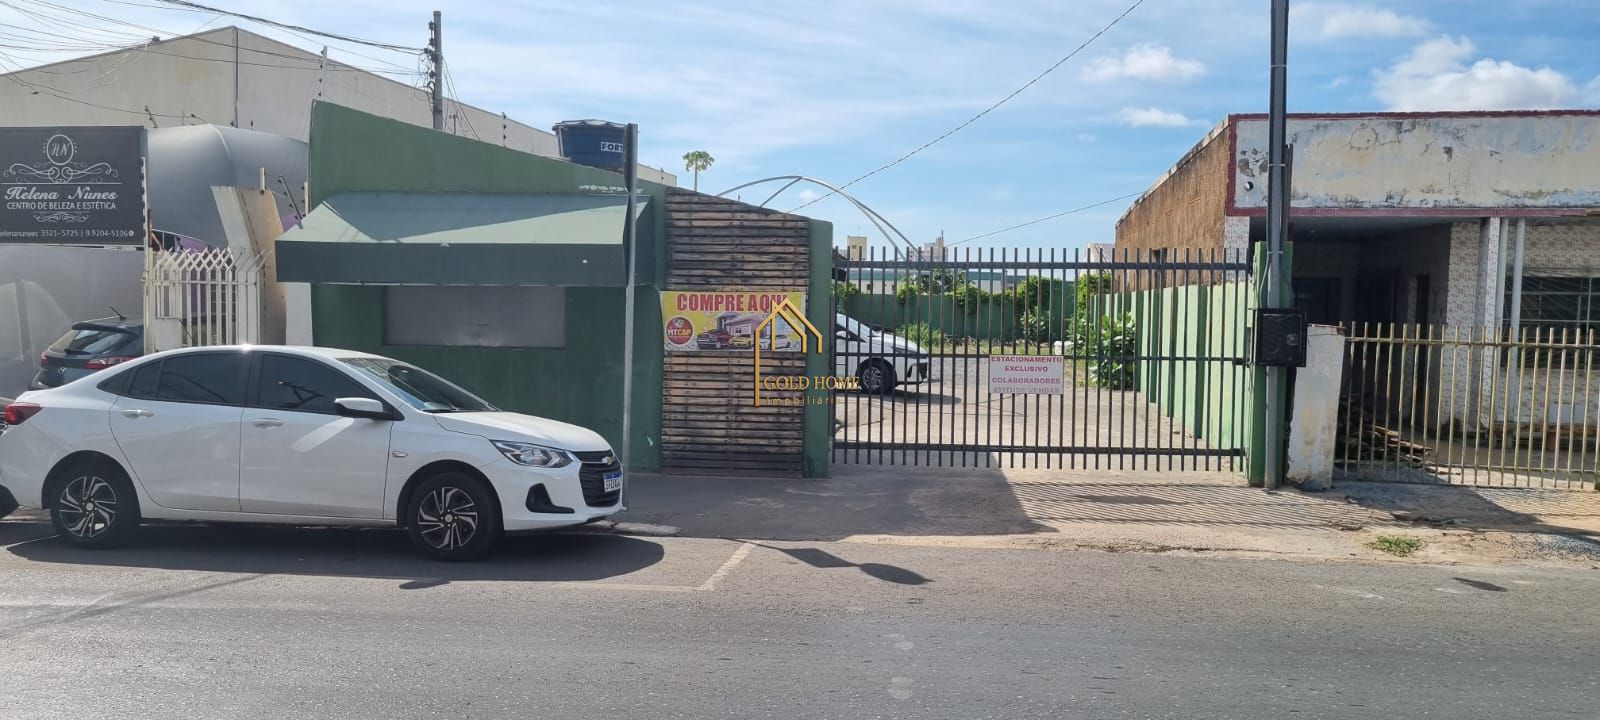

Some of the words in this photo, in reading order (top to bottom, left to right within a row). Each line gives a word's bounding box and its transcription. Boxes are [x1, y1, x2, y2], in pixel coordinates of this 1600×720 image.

[4, 186, 60, 200] Helena
[68, 186, 119, 200] Nunes
[6, 202, 36, 210] CENTRO
[38, 202, 48, 210] DE
[49, 202, 75, 210] BELEZA
[77, 202, 81, 210] E
[83, 200, 117, 210] ESTÉTICA
[40, 229, 79, 237] 3321-5725
[677, 293, 744, 311] COMPRE
